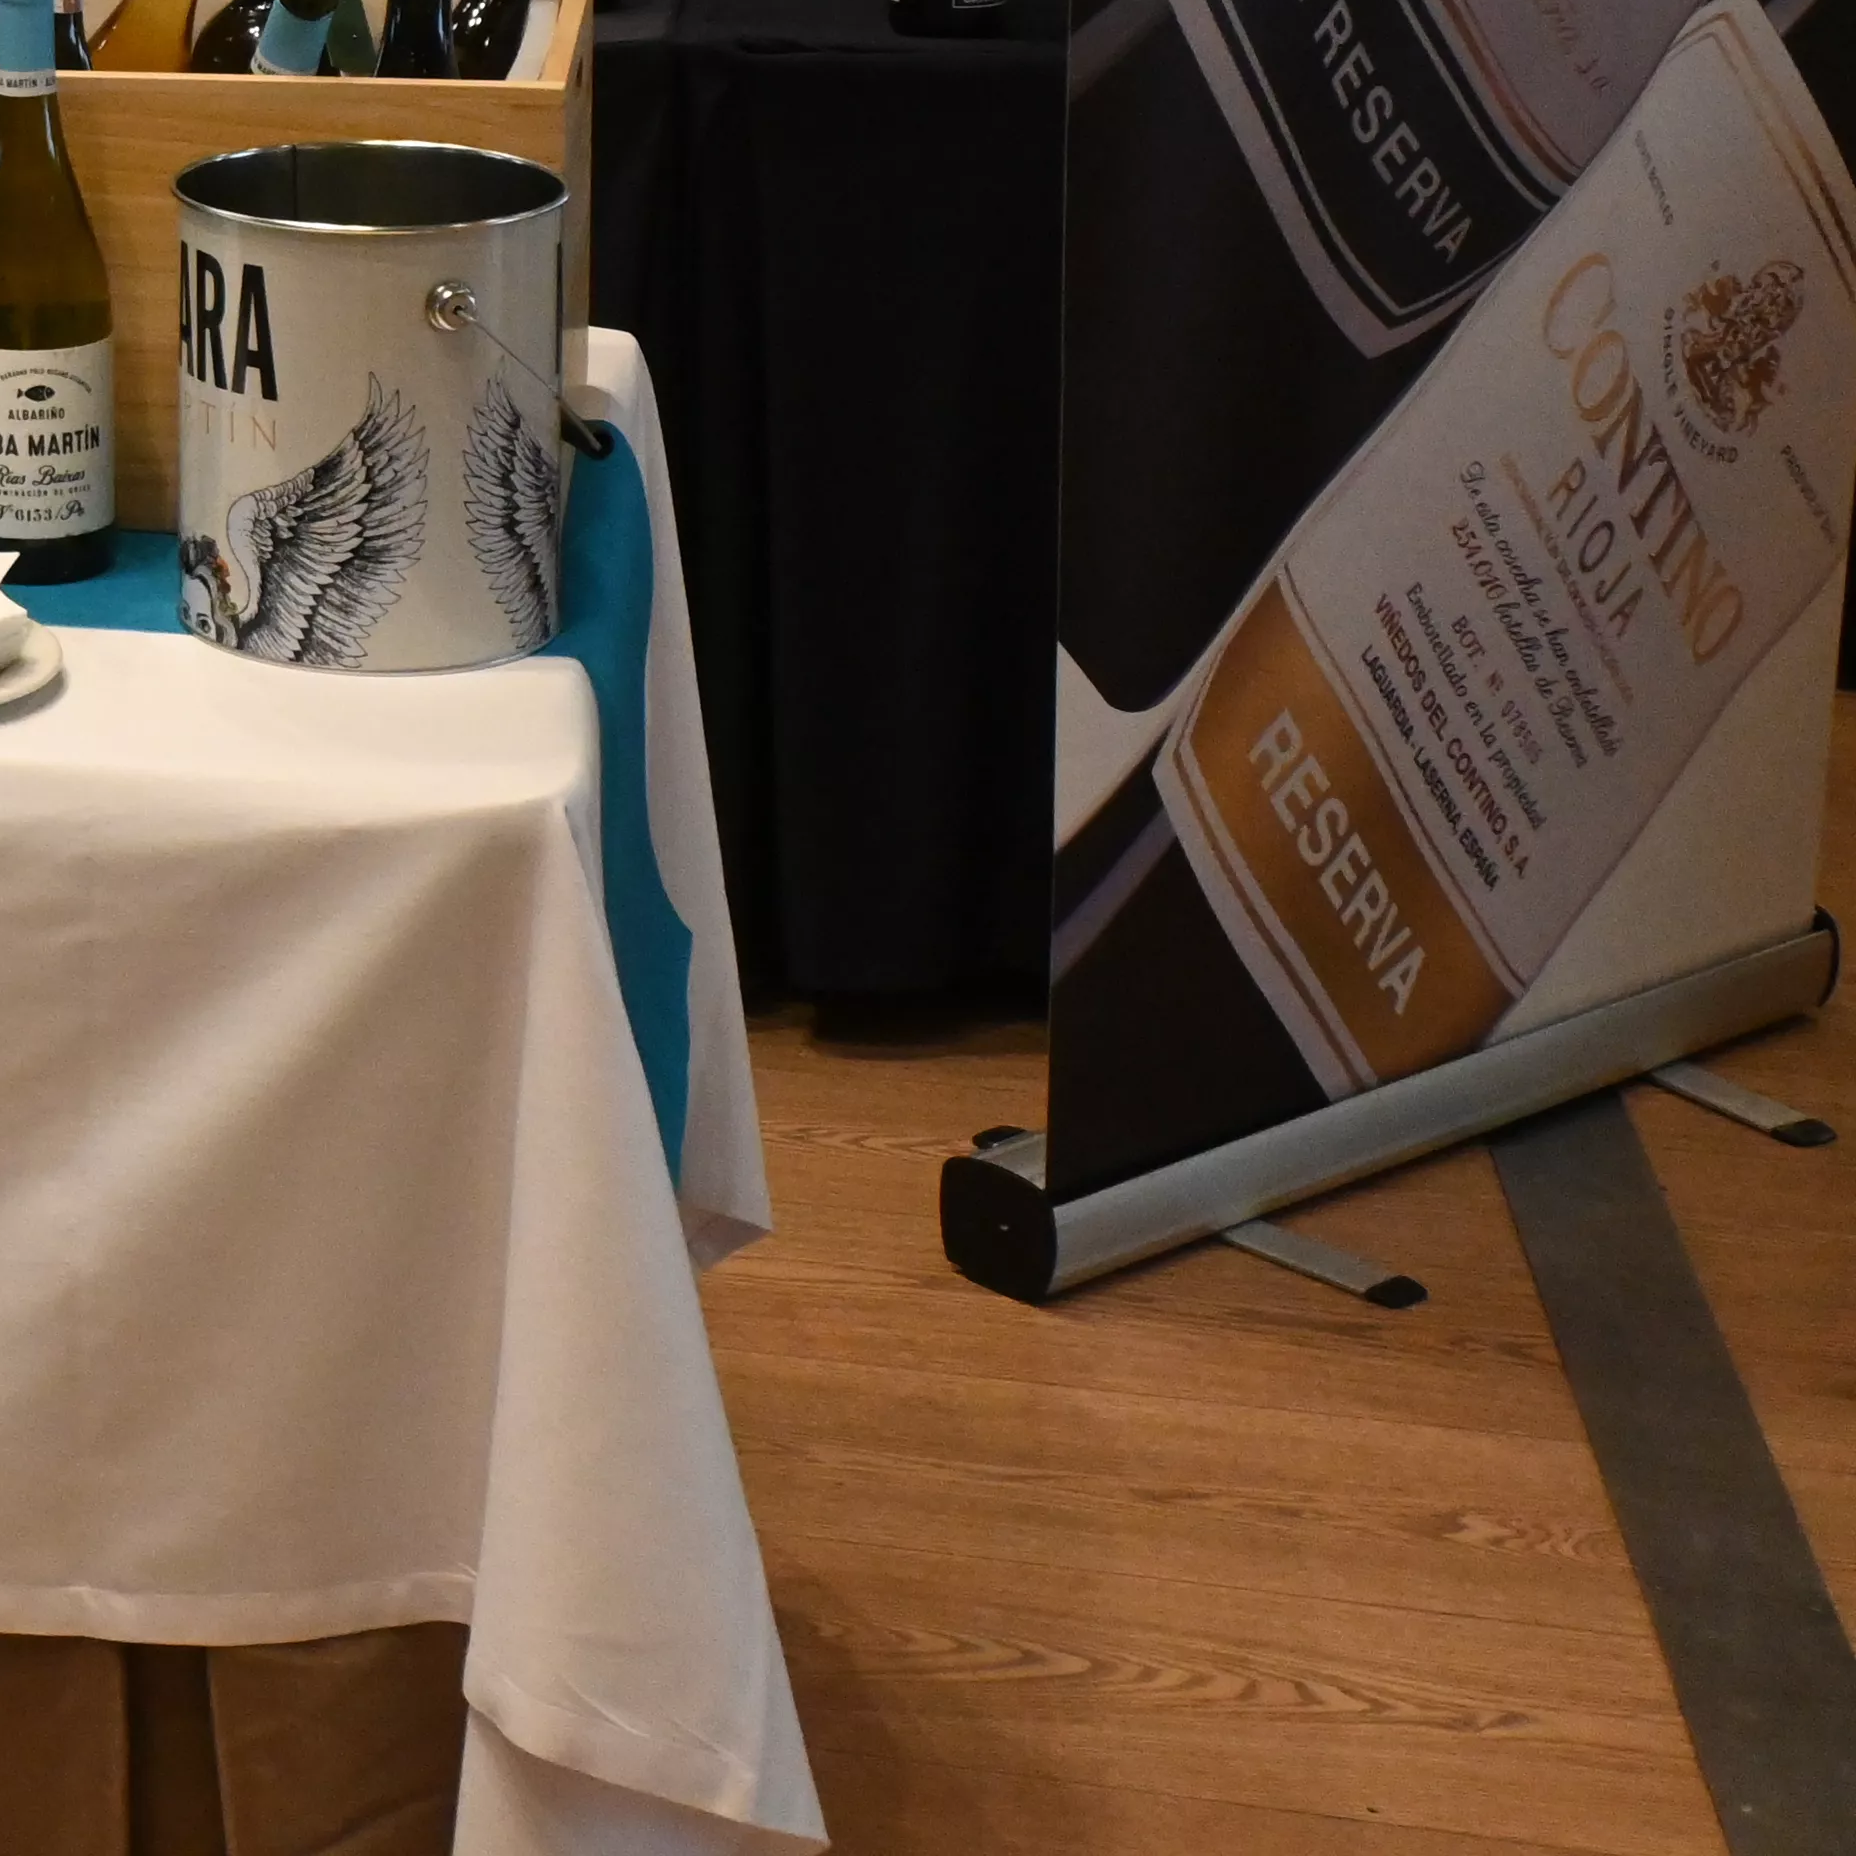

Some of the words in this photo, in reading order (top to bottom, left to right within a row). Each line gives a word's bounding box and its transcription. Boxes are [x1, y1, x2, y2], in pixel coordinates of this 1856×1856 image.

[1313, 7, 1475, 265] RESERVA
[180, 240, 278, 401] ARA
[8, 406, 66, 421] ALBARIÑO
[28, 423, 101, 457] MARTÍN
[1541, 250, 1746, 667] CONTINO
[1495, 539, 1544, 605] cosecha
[1547, 457, 1650, 639] RIOJA
[1361, 644, 1415, 745] LAGUARDIA
[1375, 592, 1427, 693] VIÑEDOS
[1421, 688, 1448, 743] DEL
[1407, 582, 1468, 698] Embotellado
[1464, 700, 1484, 726] en
[1479, 721, 1498, 749] la
[1247, 707, 1430, 1016] RESERVA
